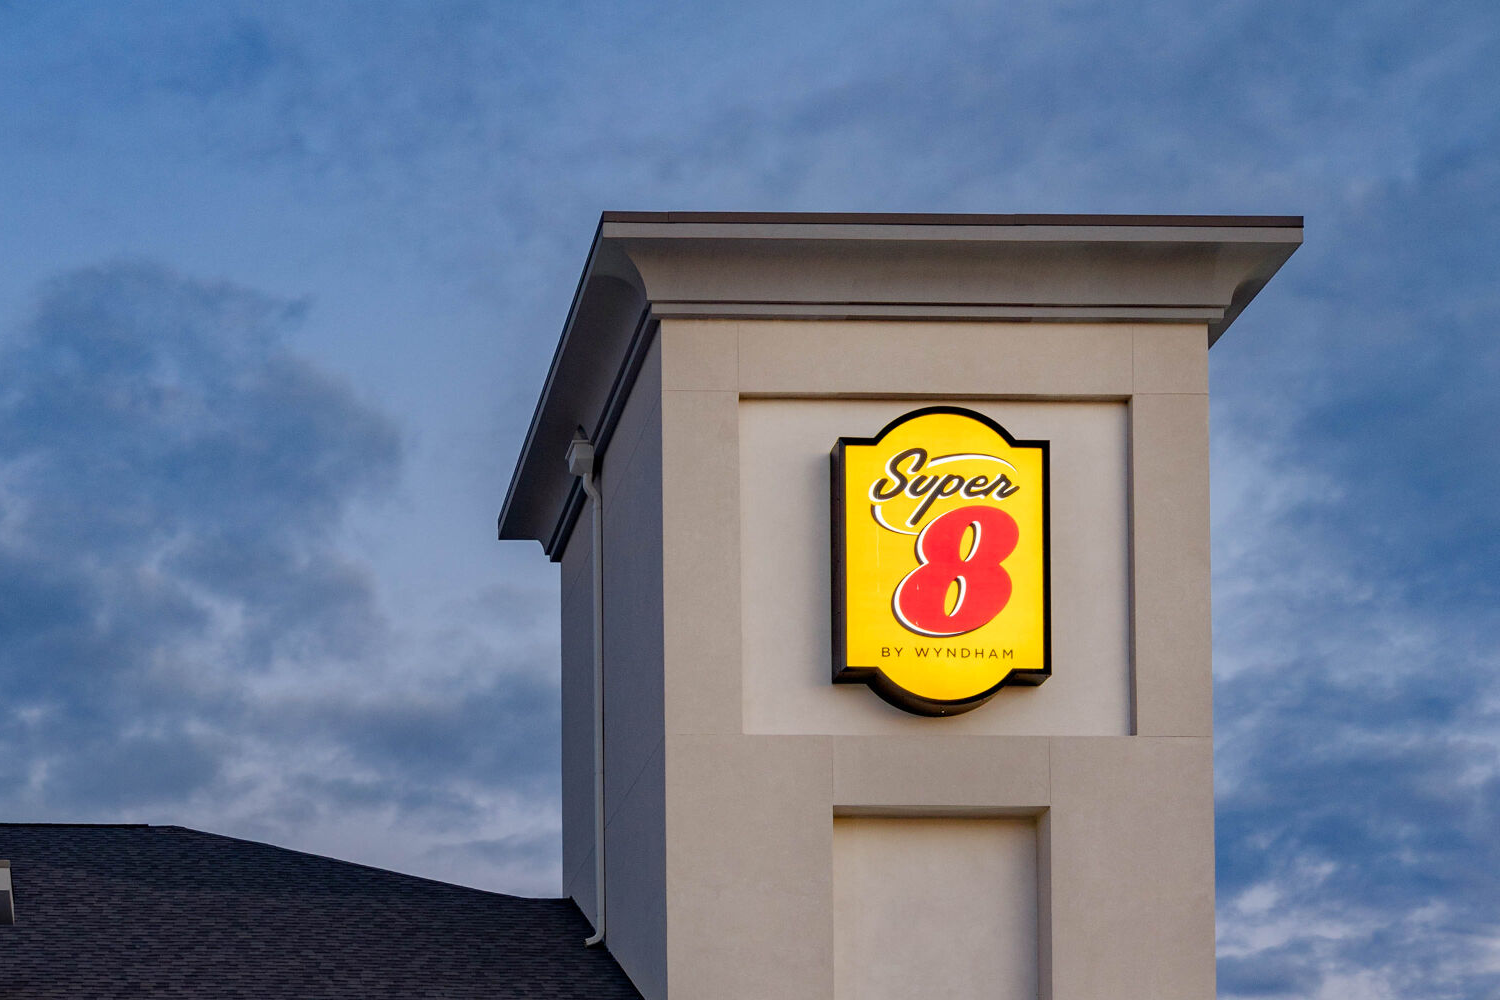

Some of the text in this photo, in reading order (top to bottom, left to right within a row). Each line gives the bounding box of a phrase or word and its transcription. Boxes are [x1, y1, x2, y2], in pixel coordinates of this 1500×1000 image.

[869, 447, 1020, 528] Super
[892, 505, 1019, 637] 8
[881, 646, 1014, 660] BY WYNDHAM
